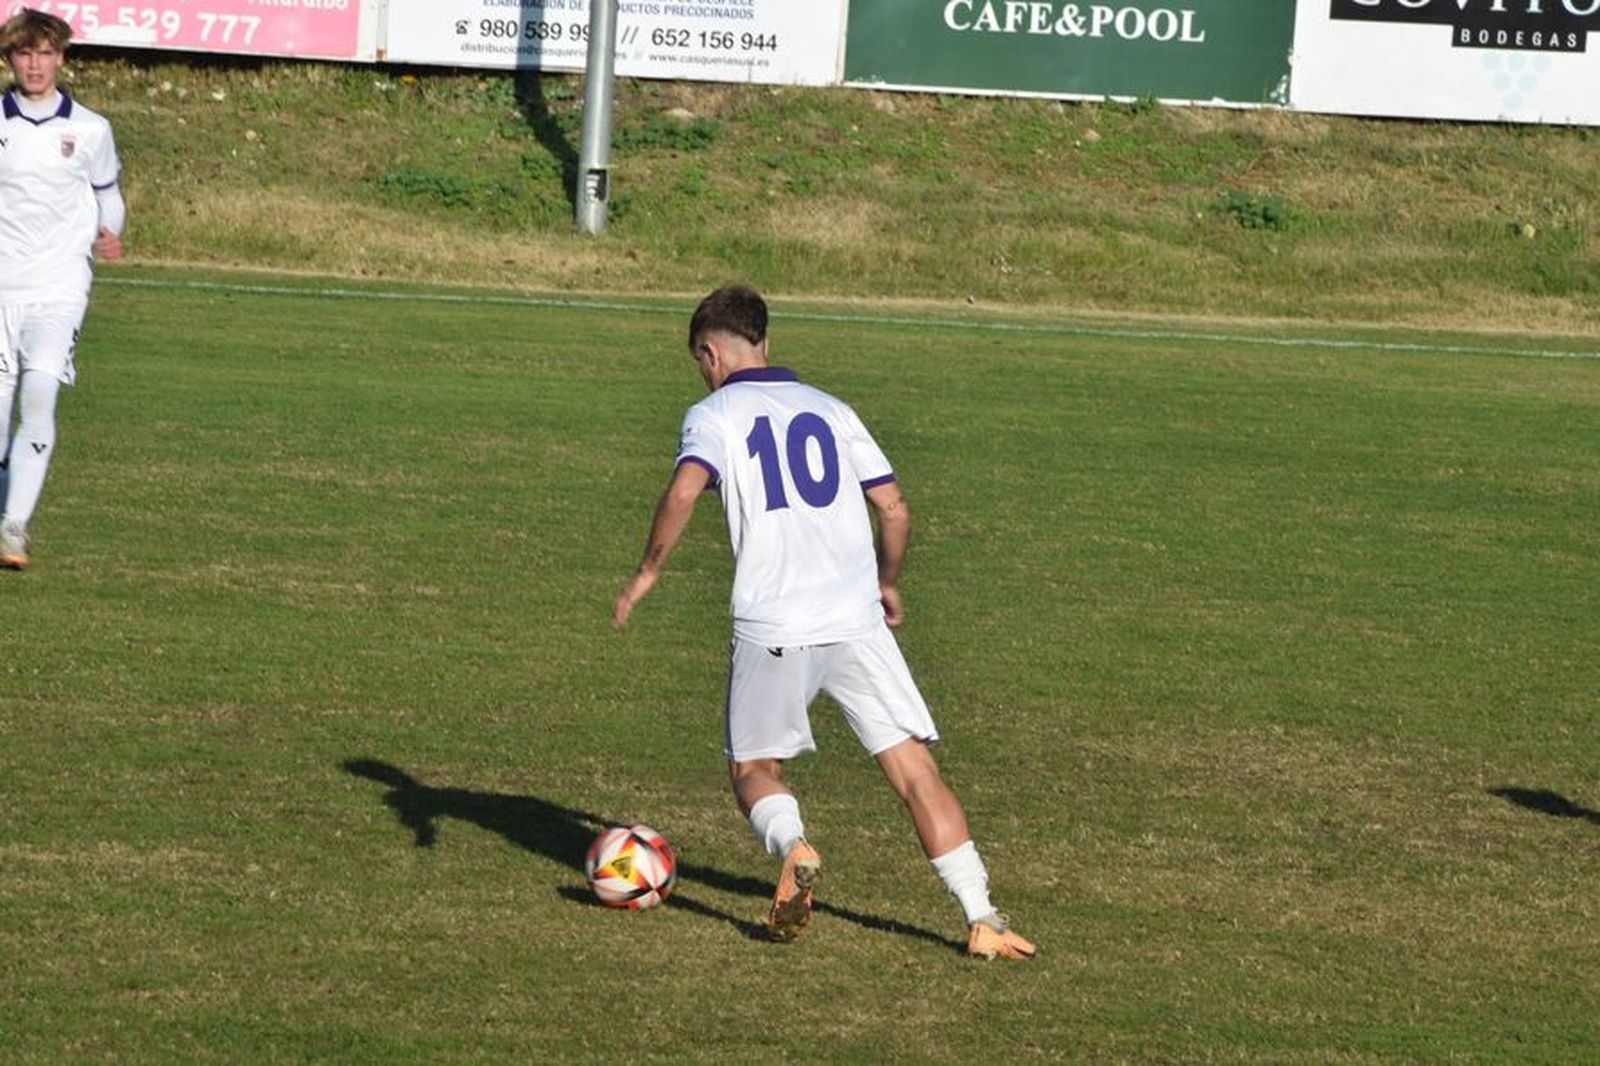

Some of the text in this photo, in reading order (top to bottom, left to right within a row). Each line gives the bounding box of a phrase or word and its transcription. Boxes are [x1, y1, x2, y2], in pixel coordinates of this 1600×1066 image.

[196, 12, 261, 45] 777
[663, 4, 755, 20] PRECOCINADOS
[943, 0, 1205, 42] CAFE&POOL
[479, 18, 519, 38] 980
[524, 20, 562, 40] 539
[651, 27, 691, 48] 652
[698, 30, 735, 50] 156
[740, 32, 777, 51] 944
[1460, 28, 1577, 47] BODEGAS
[745, 411, 840, 512] 10
